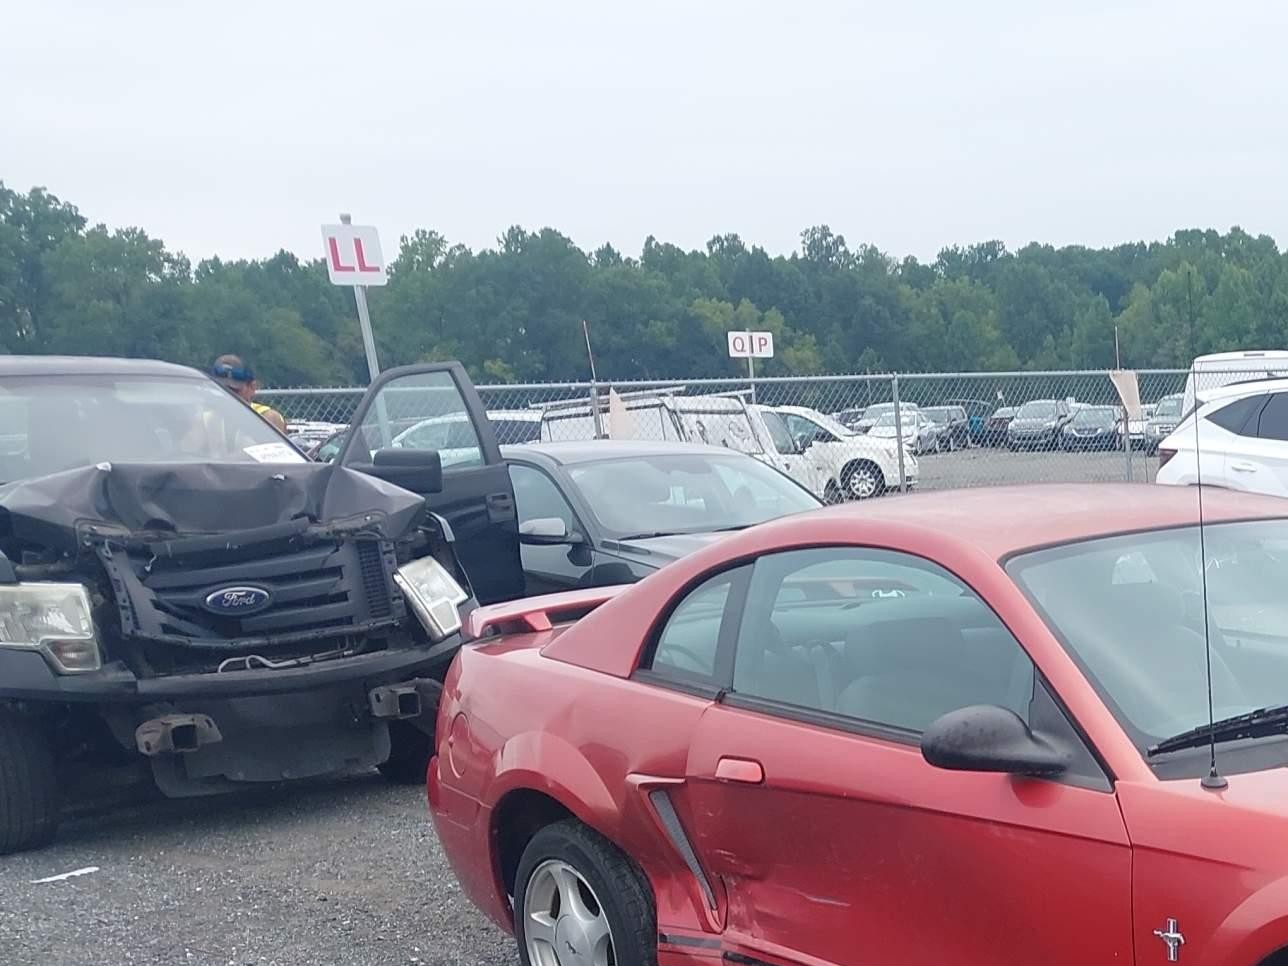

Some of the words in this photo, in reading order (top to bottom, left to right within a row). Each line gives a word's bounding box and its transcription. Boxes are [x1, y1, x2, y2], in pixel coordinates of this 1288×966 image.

[328, 236, 381, 273] LL
[732, 335, 746, 353] Q
[758, 336, 768, 353] P
[222, 591, 256, 607] Ford
